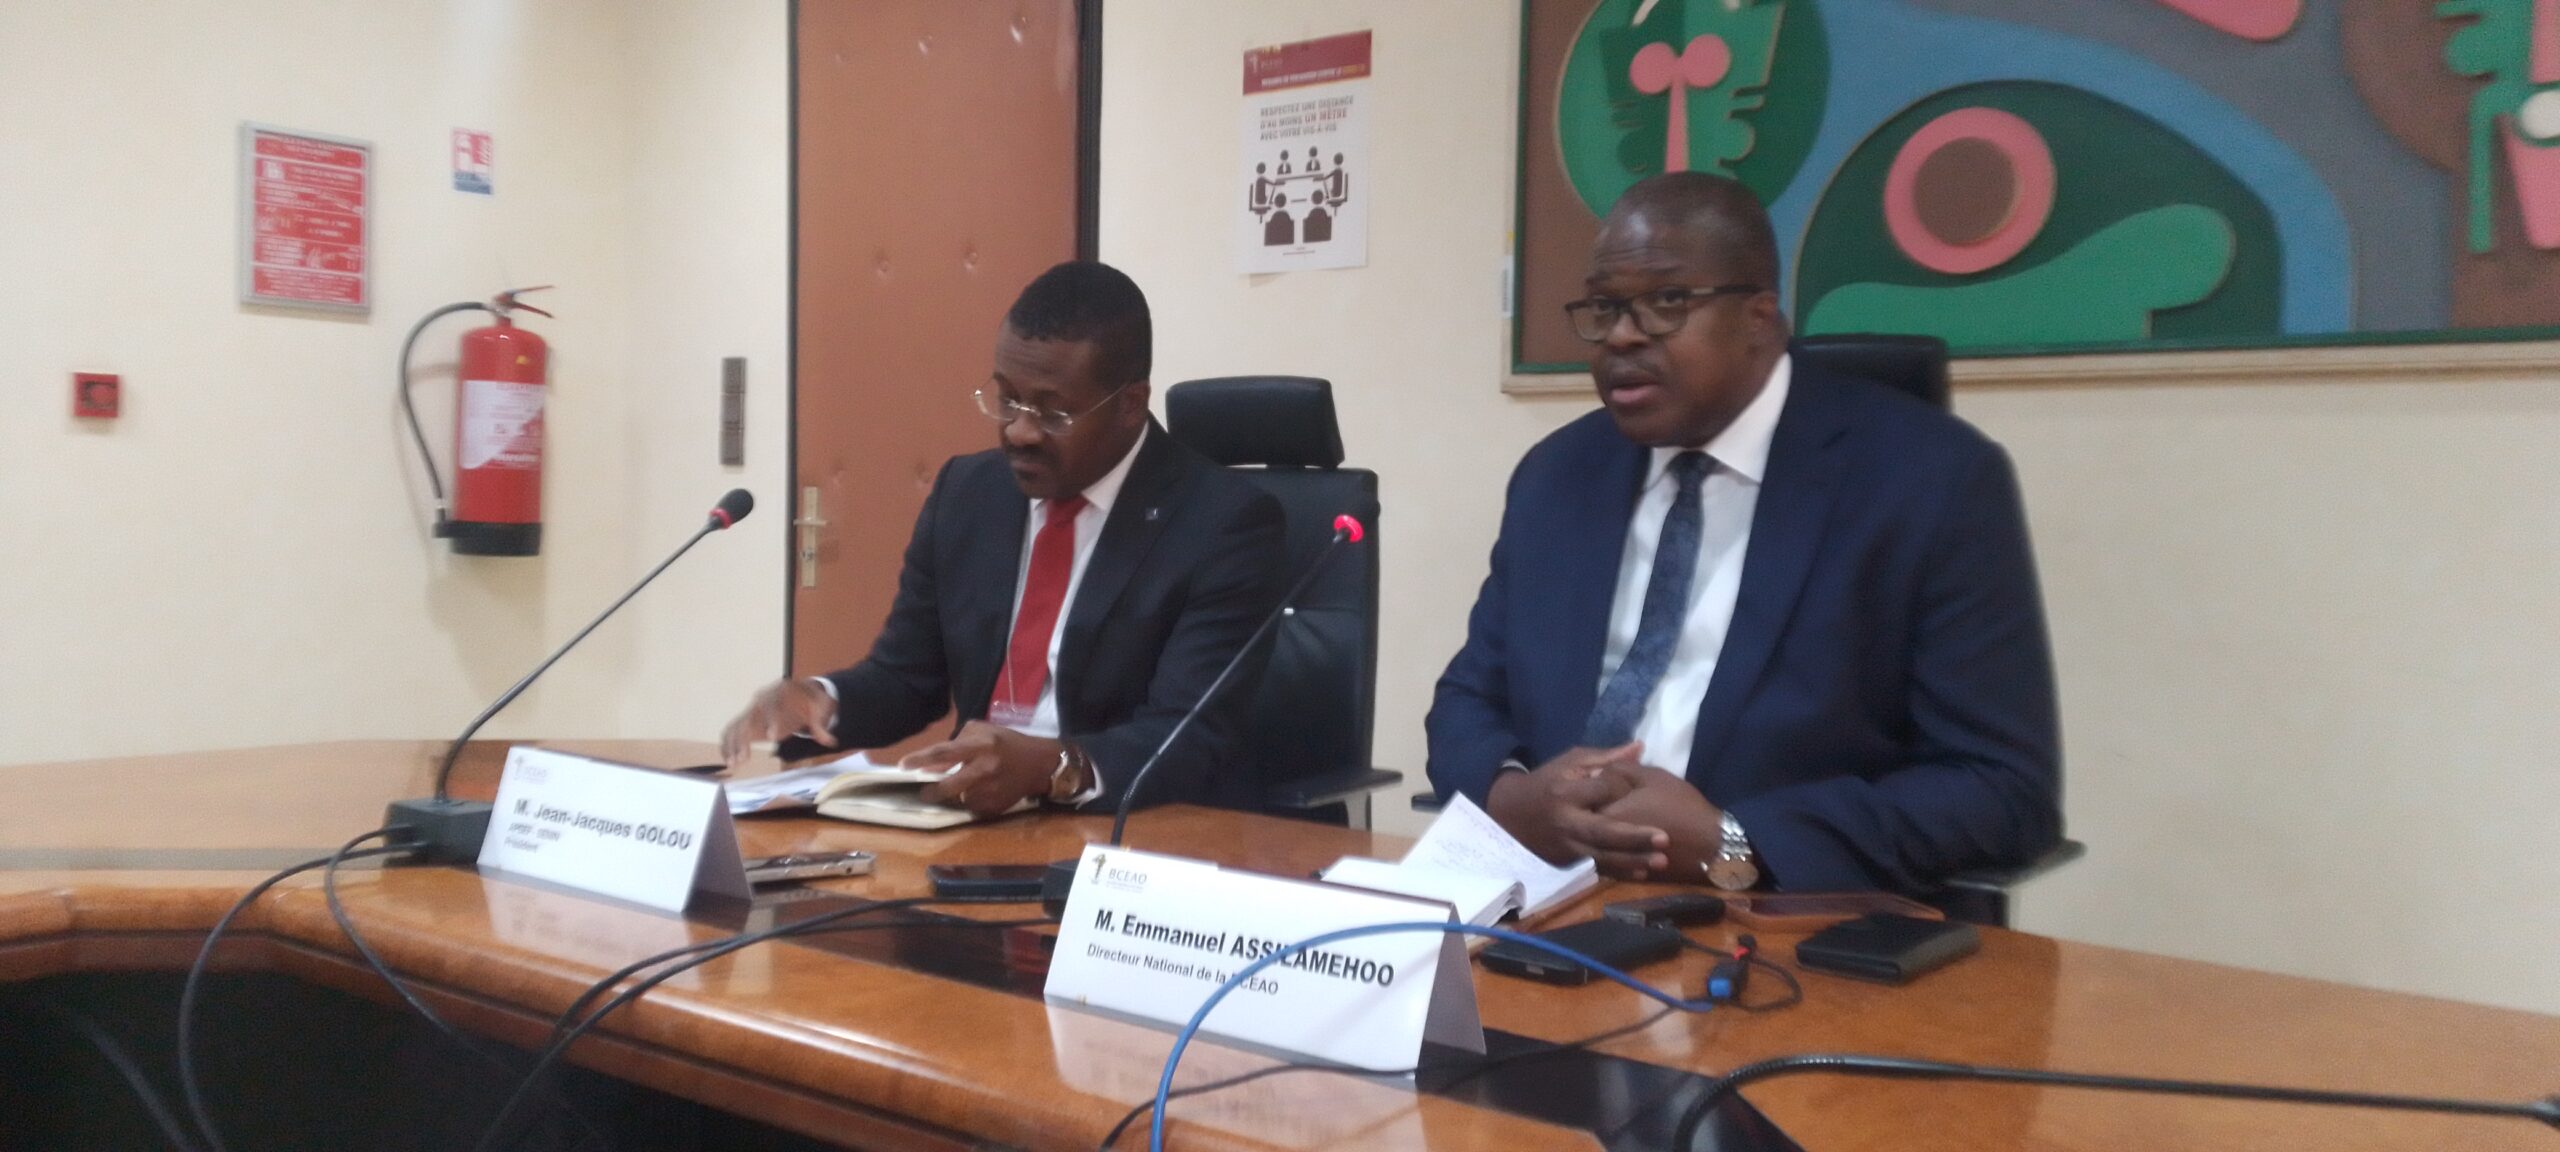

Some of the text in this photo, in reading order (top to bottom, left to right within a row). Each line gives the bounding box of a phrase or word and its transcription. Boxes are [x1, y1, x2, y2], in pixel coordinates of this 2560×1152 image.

[513, 799, 692, 850] M. Jean-Jacques GOLOU
[1109, 868, 1147, 884] BCEAO
[1094, 908, 1115, 932] M.
[1121, 913, 1226, 954] Emmanuel
[1086, 943, 1279, 996] Directeur National de la CEAO
